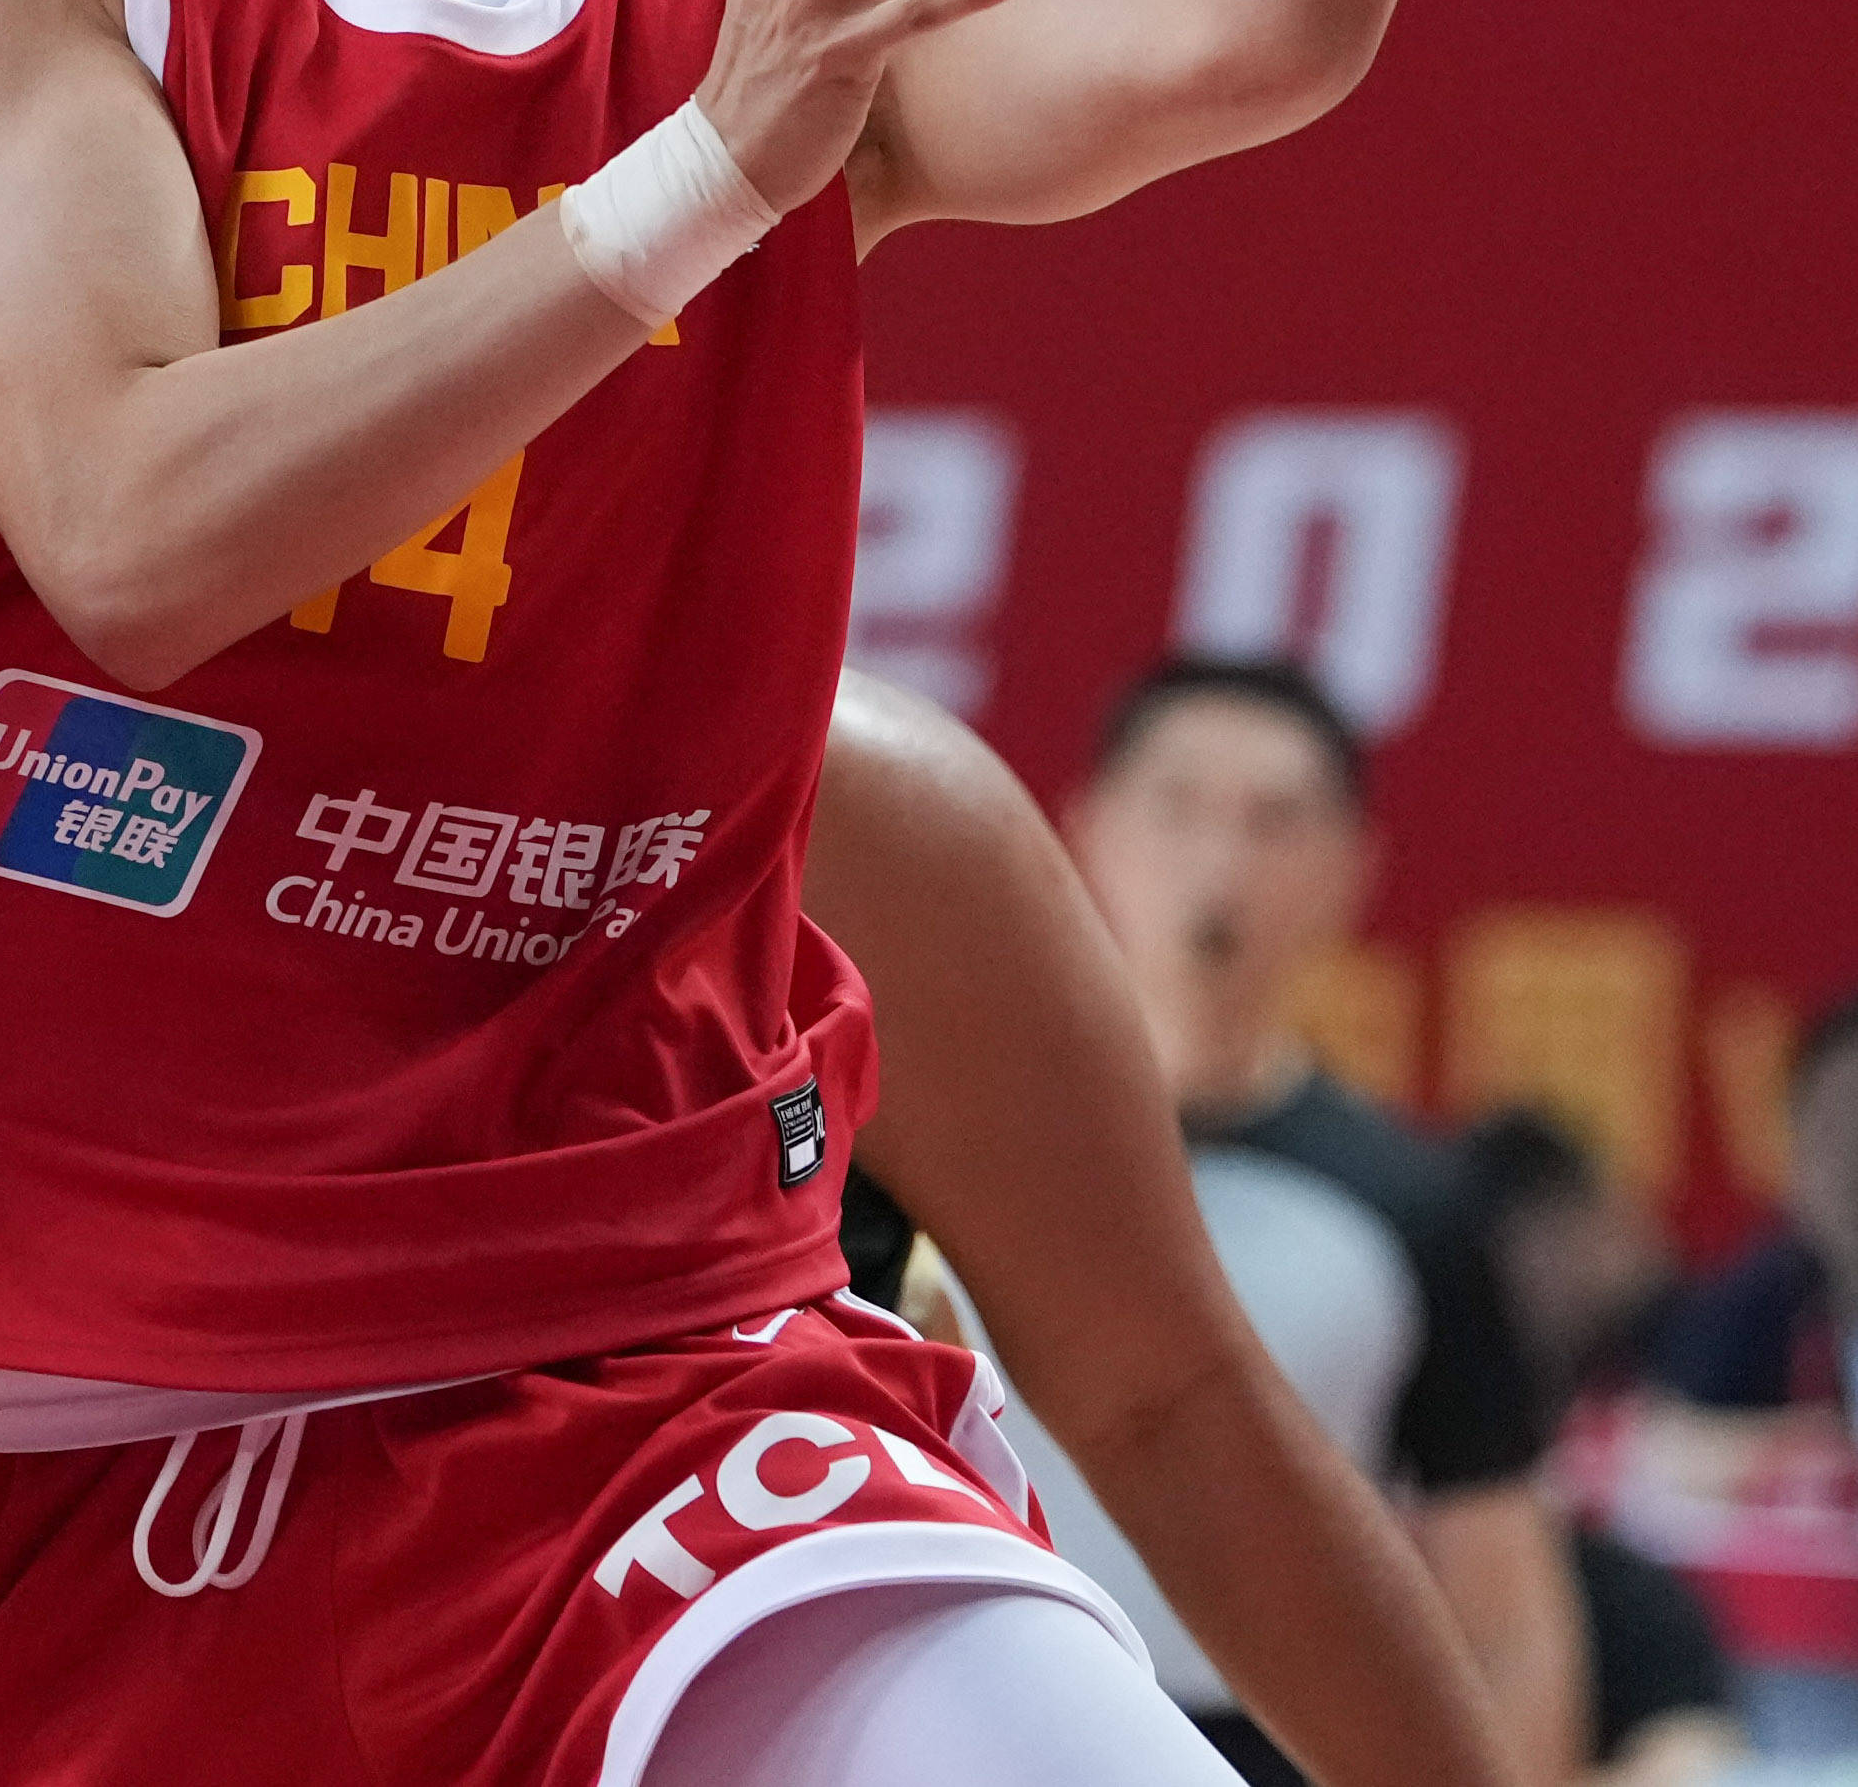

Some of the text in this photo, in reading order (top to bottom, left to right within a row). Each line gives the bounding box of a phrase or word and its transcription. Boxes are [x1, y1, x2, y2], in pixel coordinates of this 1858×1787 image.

[220, 161, 681, 346] CHI
[289, 447, 525, 663] 4
[53, 799, 180, 869] 银联
[295, 788, 712, 911] 中国银联
[265, 875, 424, 948] China
[593, 1411, 998, 1600] TCL
